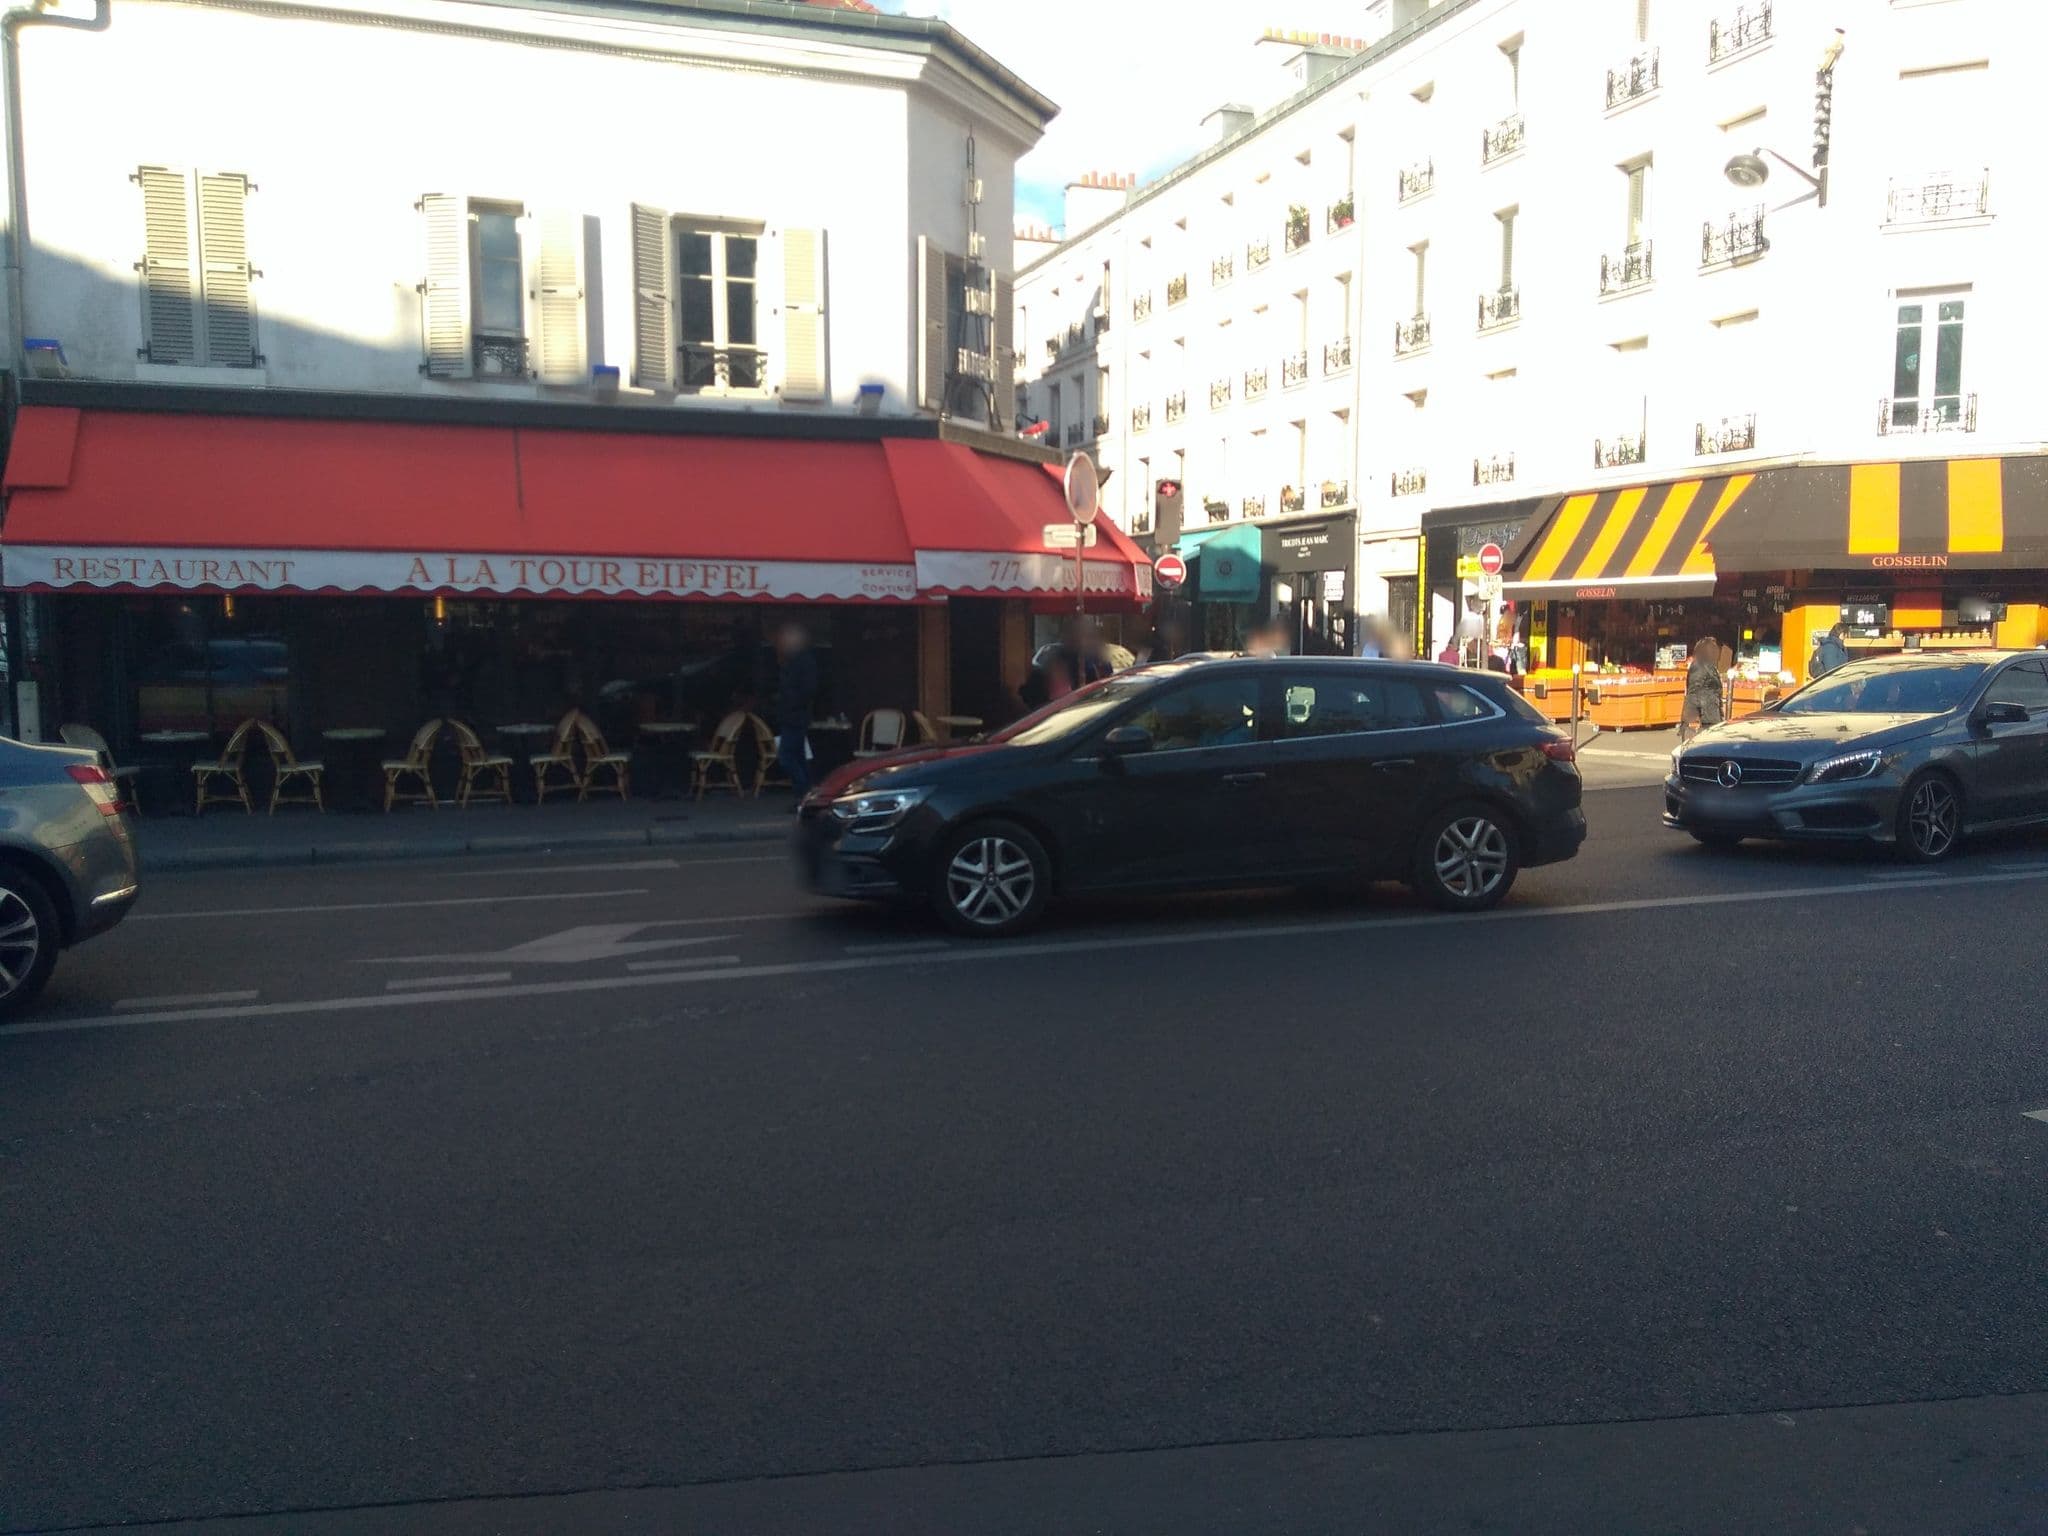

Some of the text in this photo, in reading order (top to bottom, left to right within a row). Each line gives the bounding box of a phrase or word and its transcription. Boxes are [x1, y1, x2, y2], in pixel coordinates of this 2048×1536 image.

[1872, 556, 1948, 566] GOSSELIN
[52, 557, 295, 582] RESTAURANT
[406, 557, 770, 590] A LA TOUR EIFFEL
[861, 568, 914, 578] SERVICE
[989, 561, 1020, 581] 7/7
[1575, 587, 1616, 598] GOSSELIN
